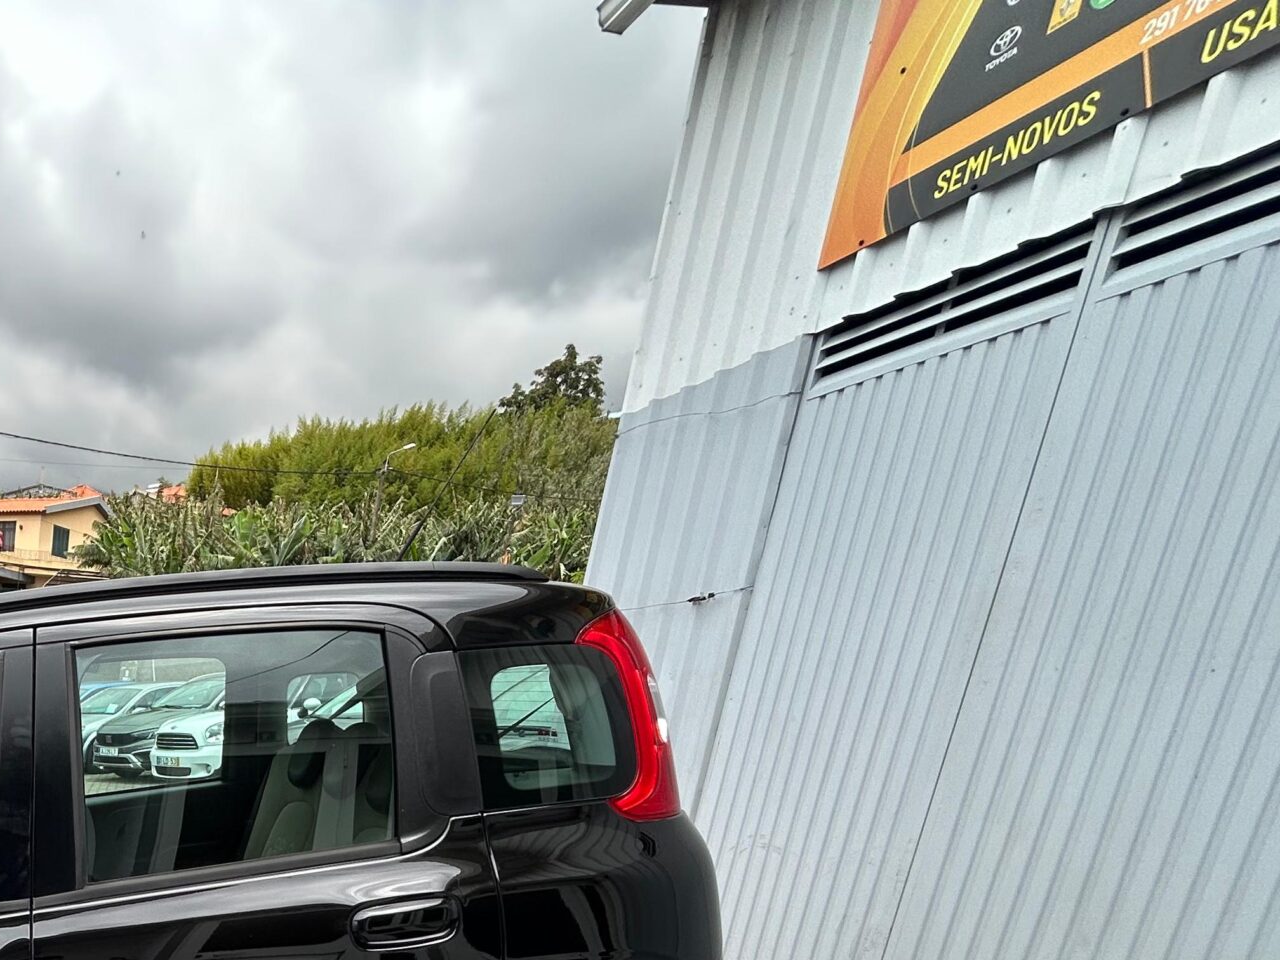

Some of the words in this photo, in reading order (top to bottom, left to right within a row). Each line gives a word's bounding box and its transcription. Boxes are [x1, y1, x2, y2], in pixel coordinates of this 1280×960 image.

[1139, 5, 1181, 46] 291
[985, 47, 1018, 72] TOYOTA
[933, 90, 1101, 199] SEMI-NOVOS
